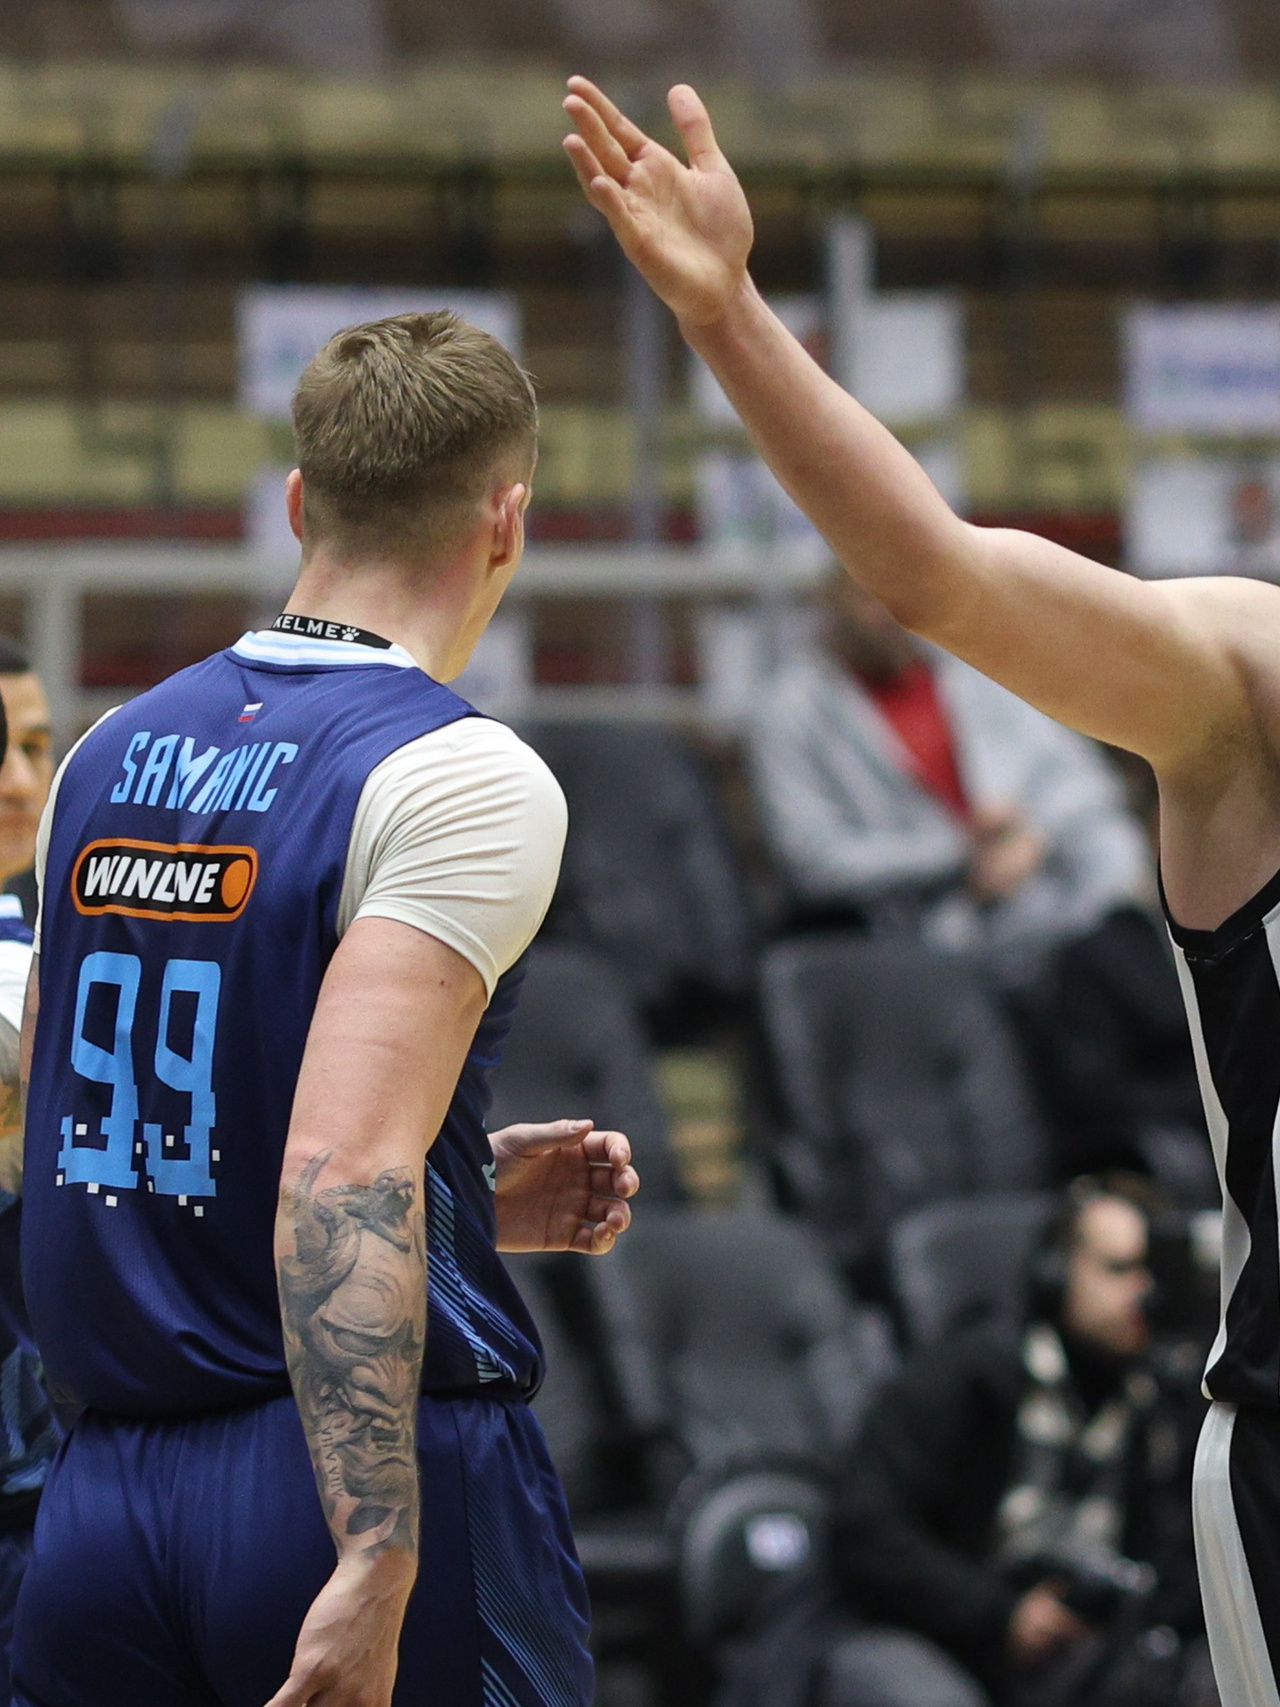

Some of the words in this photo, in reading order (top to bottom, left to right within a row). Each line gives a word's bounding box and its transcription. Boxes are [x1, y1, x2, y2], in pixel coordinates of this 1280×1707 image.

[272, 614, 341, 639] KELME
[110, 731, 298, 814] SAMANIC
[84, 855, 220, 904] WINLNE
[57, 951, 221, 1198] 99
